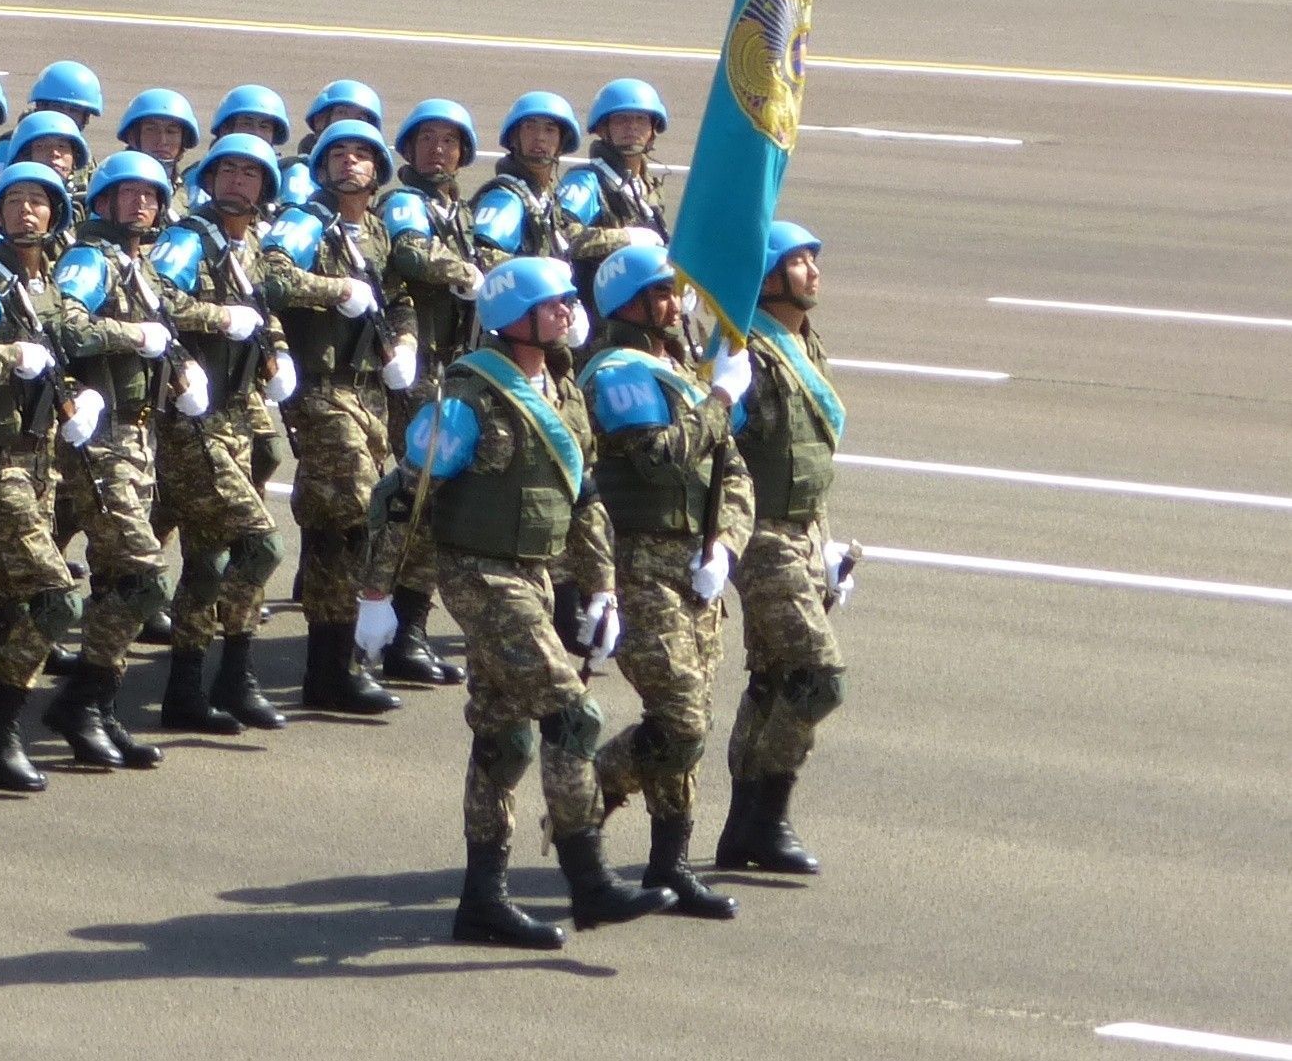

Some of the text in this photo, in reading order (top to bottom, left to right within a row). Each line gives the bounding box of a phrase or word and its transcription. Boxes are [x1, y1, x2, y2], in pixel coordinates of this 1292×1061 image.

[482, 270, 516, 301] UN
[597, 256, 627, 288] UN
[610, 384, 659, 413] UN
[414, 418, 462, 461] UN
